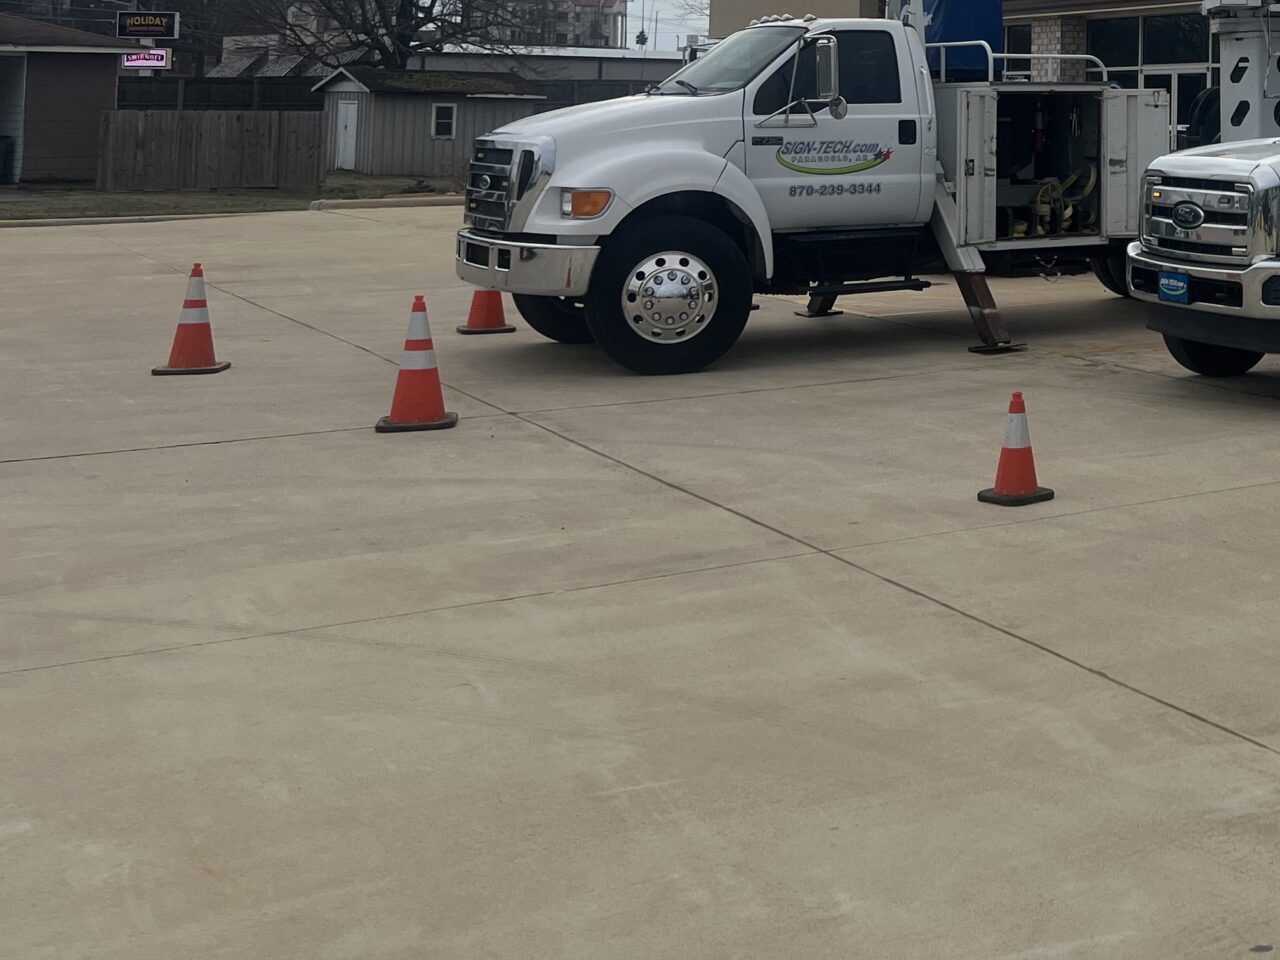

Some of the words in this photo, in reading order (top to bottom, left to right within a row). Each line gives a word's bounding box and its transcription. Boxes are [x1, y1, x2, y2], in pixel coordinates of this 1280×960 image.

[127, 16, 168, 26] HOLIDAY
[781, 140, 879, 155] SIGN-TECH.com
[788, 183, 882, 197] 870-239-3344
